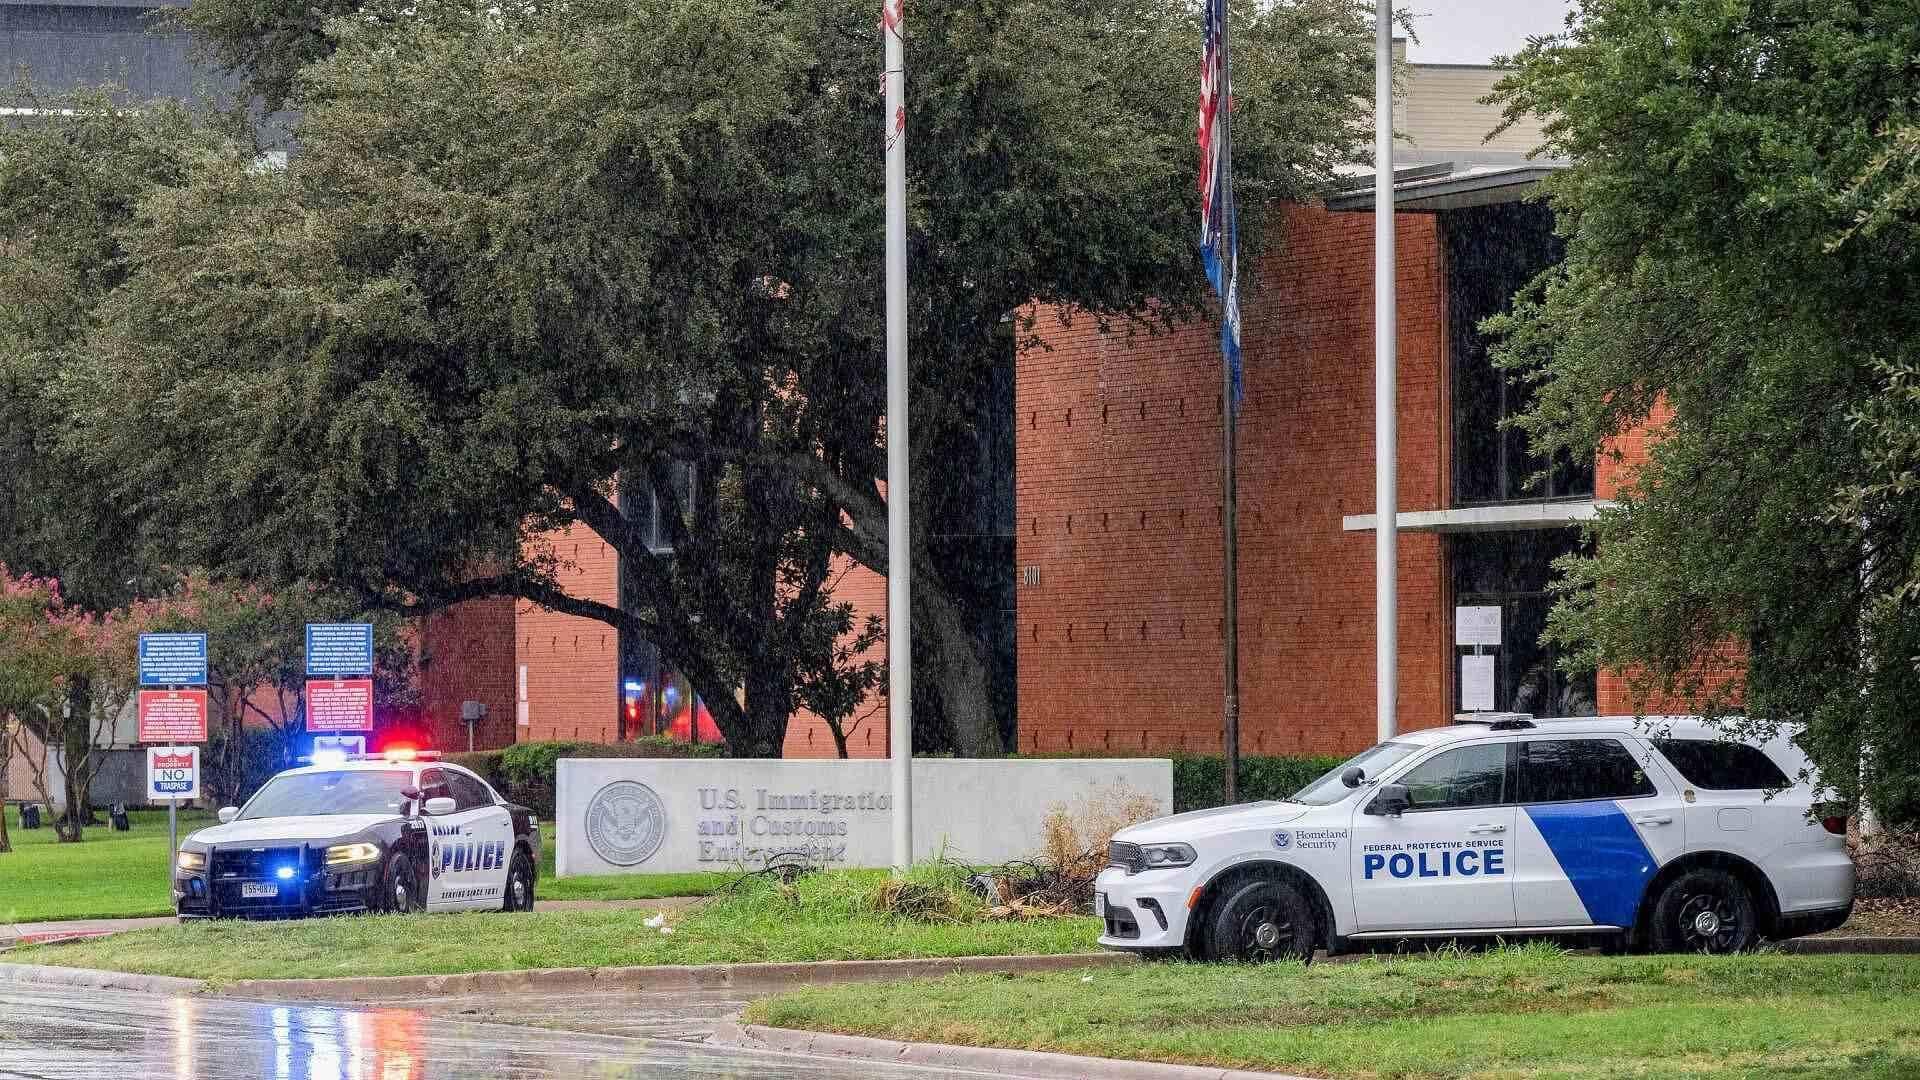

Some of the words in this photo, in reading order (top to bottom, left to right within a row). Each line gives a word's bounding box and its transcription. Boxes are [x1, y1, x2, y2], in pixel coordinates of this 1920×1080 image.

[1024, 566, 1040, 585] 8101
[162, 769, 185, 781] NO
[698, 788, 746, 810] U.S.
[698, 815, 738, 836] and
[750, 815, 848, 837] Customs
[1295, 829, 1348, 840] Homeland
[1296, 840, 1337, 850] Security
[1363, 844, 1404, 852] FEDERAL
[1406, 841, 1462, 850] PROTECTIVE
[1465, 839, 1504, 848] SERVICE
[442, 840, 505, 873] POLICE
[1364, 849, 1505, 880] POLICE
